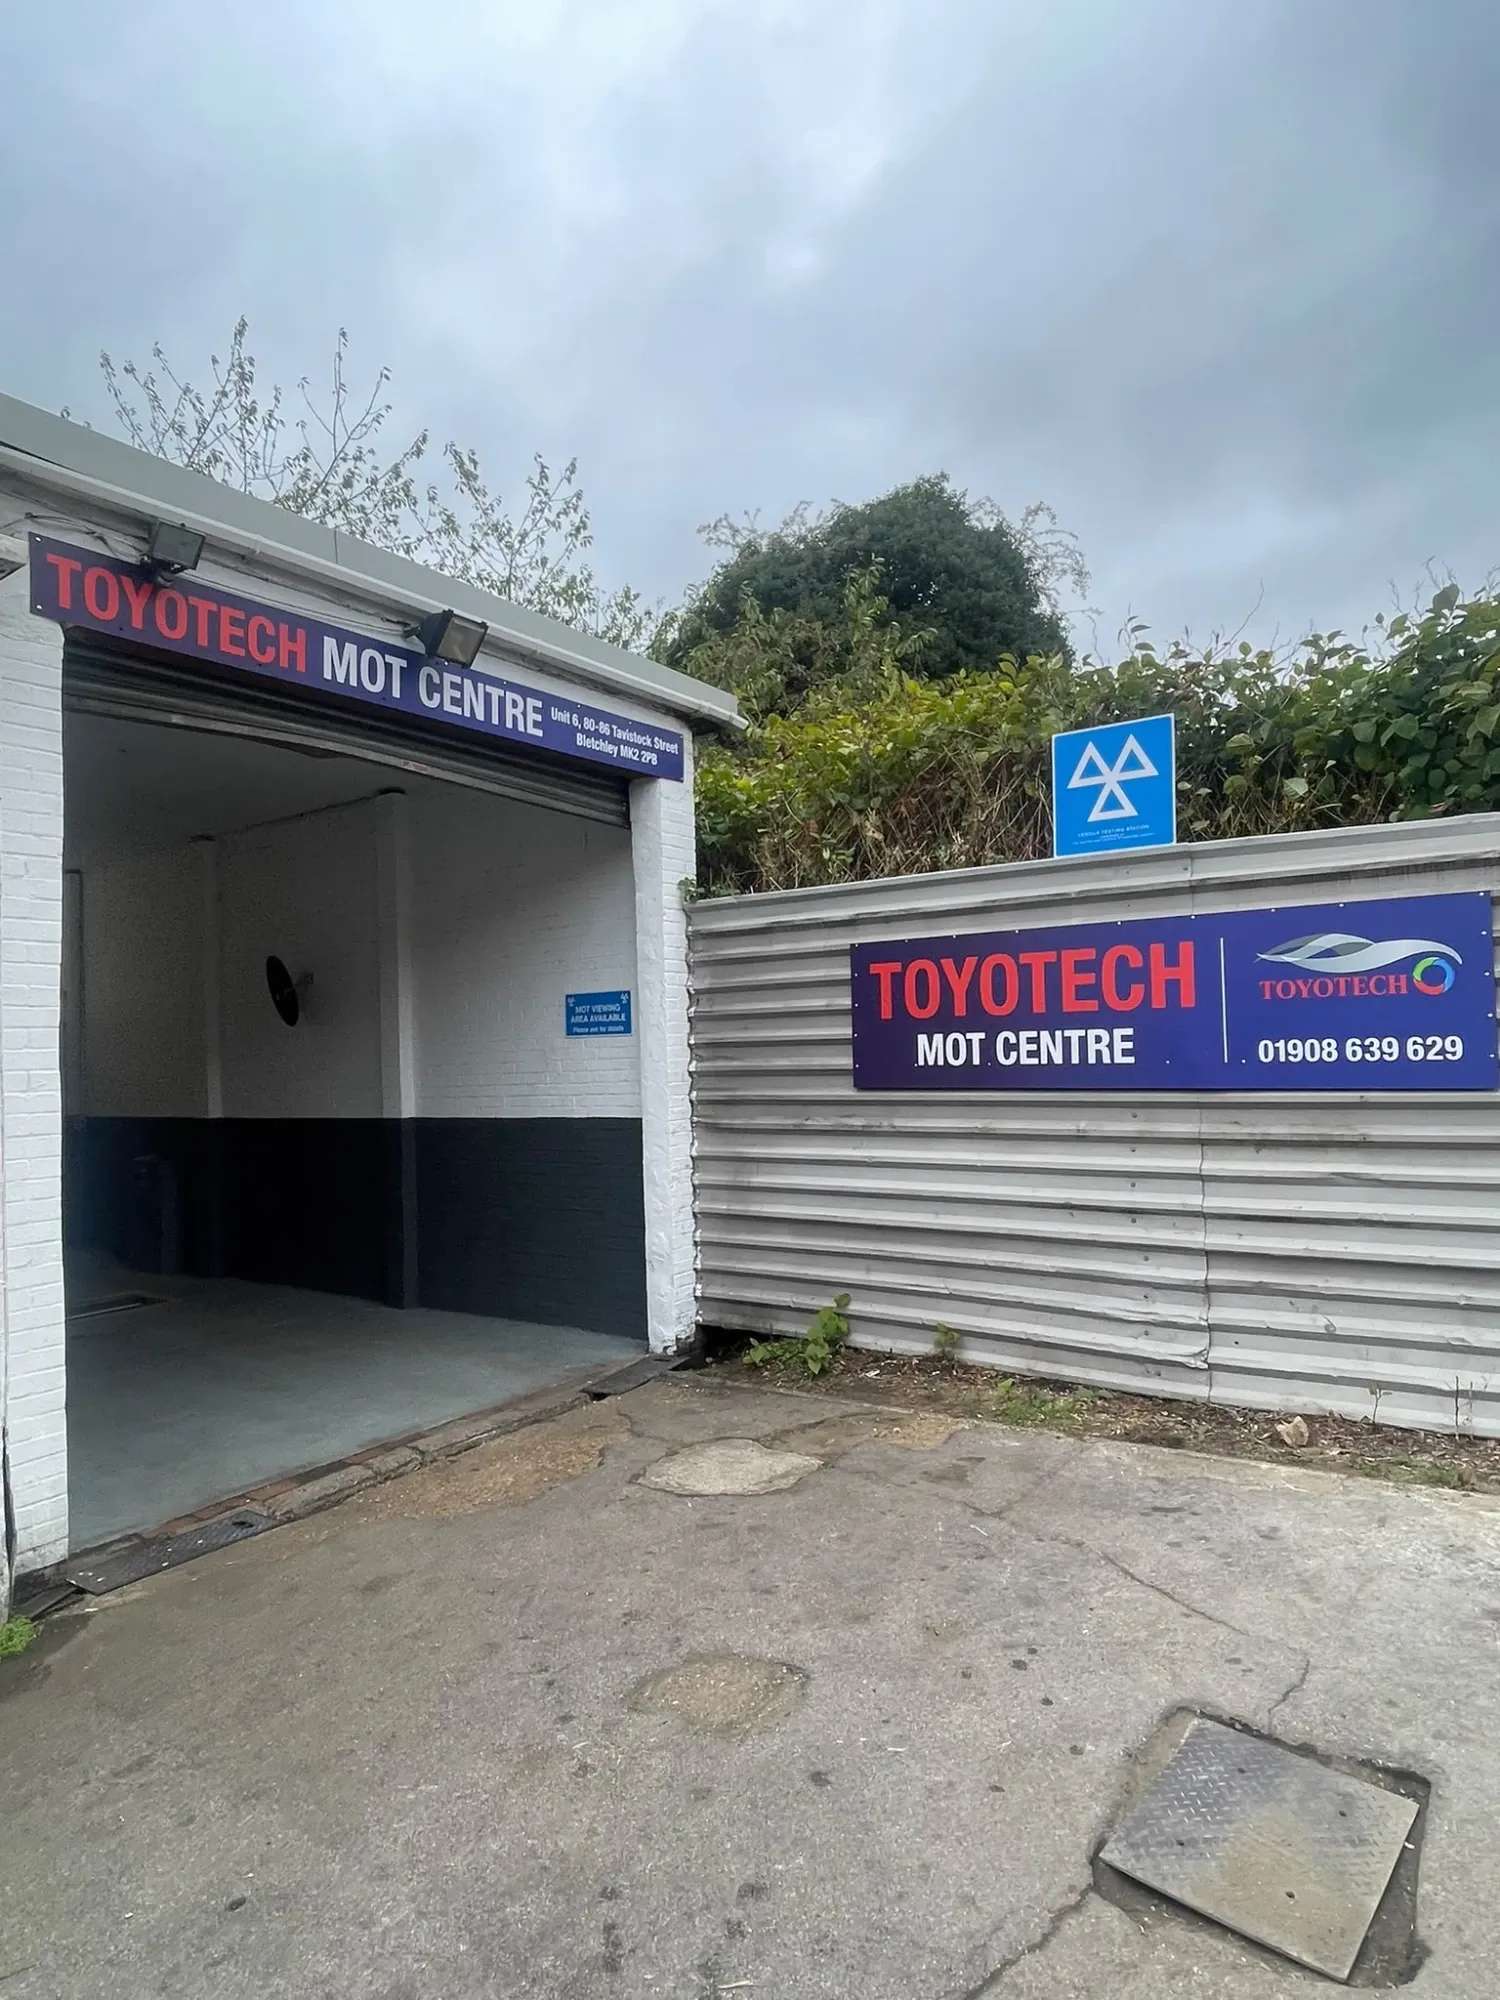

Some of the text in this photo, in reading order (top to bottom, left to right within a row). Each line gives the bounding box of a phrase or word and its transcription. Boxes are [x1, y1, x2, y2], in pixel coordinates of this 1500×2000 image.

[46, 553, 544, 737] TOYOTECH MOT CENTRE
[551, 706, 679, 755] Unit 6, 80-86 Tavistock Street
[576, 732, 658, 766] Bletchley MK2 2PB
[869, 940, 1196, 1020] TOYOTECH
[1259, 974, 1409, 1000] TOYOTECH
[571, 1013, 626, 1024] AREA AVAILABLE
[575, 1003, 620, 1014] MOT VIEWING
[917, 1028, 1136, 1067] MOT CENTRE
[1258, 1035, 1463, 1063] 01908 639 629
